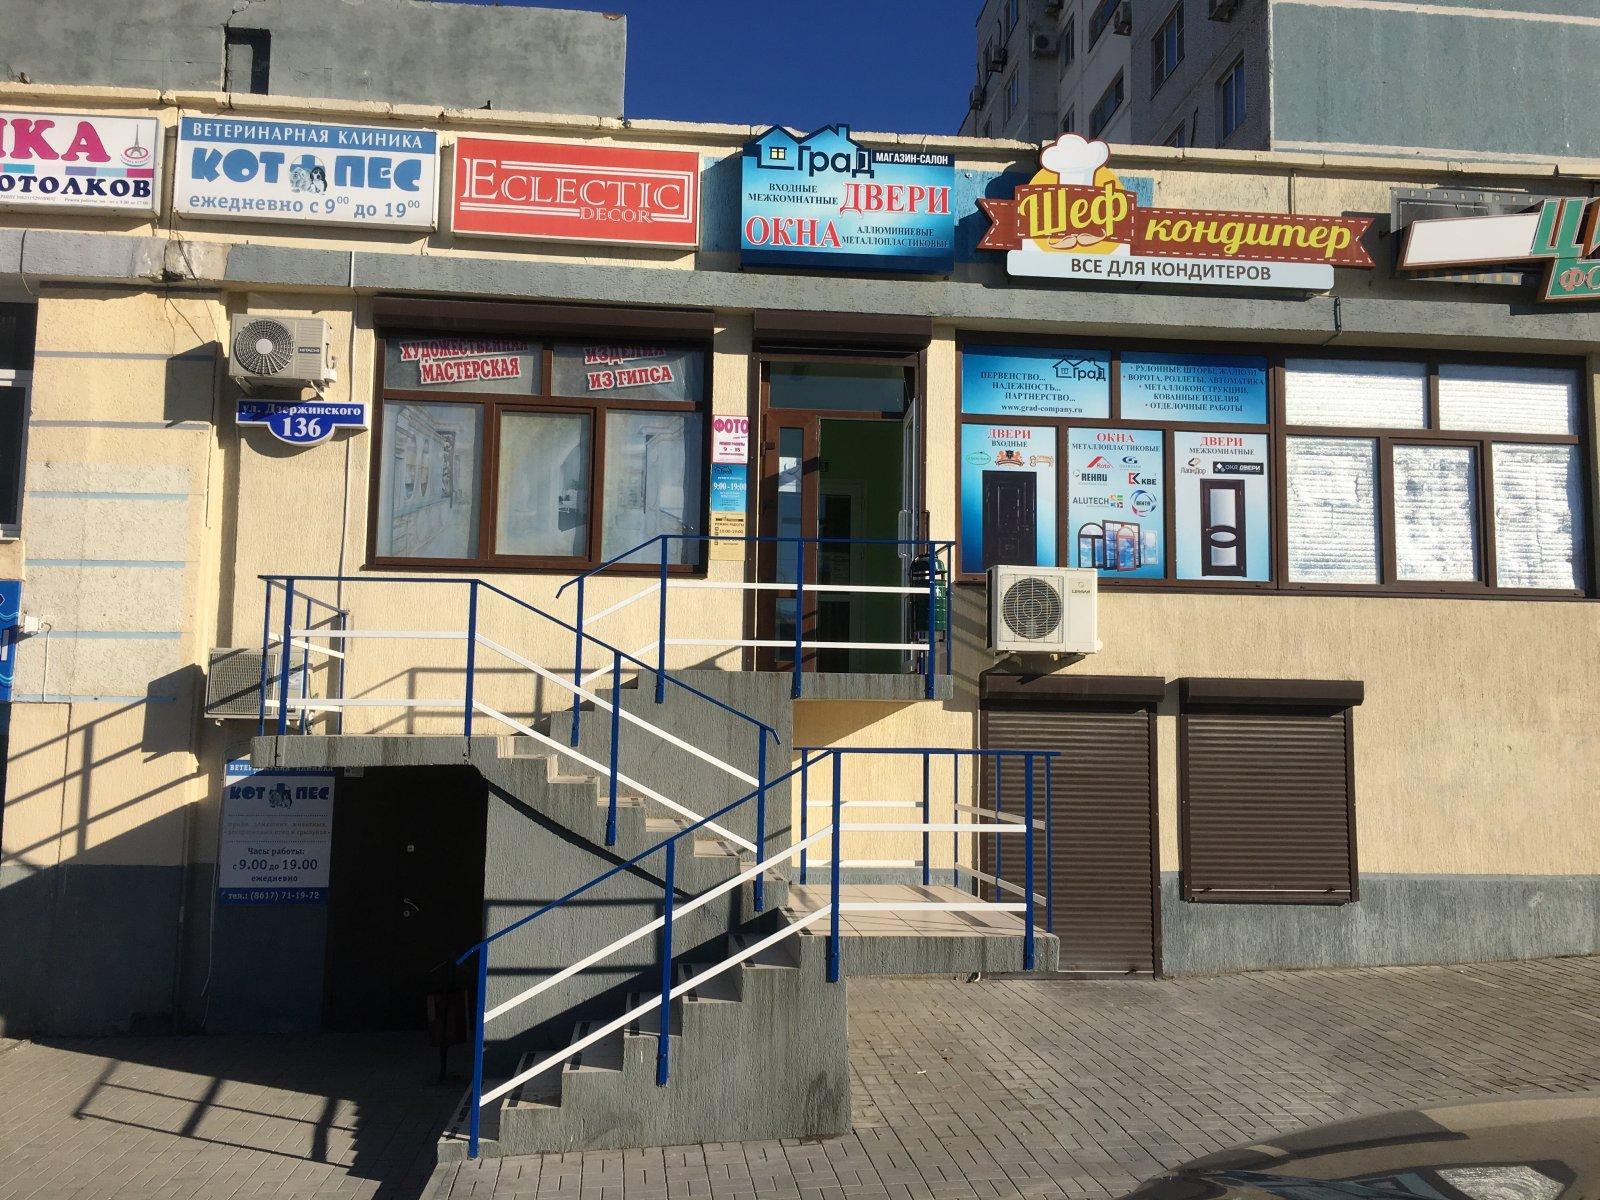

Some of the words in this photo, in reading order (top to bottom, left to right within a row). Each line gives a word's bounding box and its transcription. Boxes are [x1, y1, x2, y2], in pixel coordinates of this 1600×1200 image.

[193, 122, 329, 143] ВЕТЕРИНАРНАЯ
[338, 130, 422, 149] КЛИНИКА
[876, 151, 949, 165] МАГАЗИН-САЛОН
[191, 147, 285, 183] КОТ
[334, 155, 422, 192] ПЕС
[769, 183, 818, 193] ВХОДНЫЕ
[748, 193, 839, 205] МЕЖКОМНАТНЫЕ
[839, 182, 951, 218] ДВЕРИ
[189, 195, 304, 212] ежедневно
[309, 201, 319, 213] с
[354, 204, 377, 219] до
[1019, 182, 1128, 238] Шеф
[580, 206, 654, 223] DECOR
[745, 215, 842, 248] ОКНА
[857, 225, 935, 237] АЛЛЮМИНИЕВЫЕ
[842, 235, 949, 248] МЕТАЛЛОПЛАСТИКОВЫЕ
[1145, 218, 1351, 259] кондитер
[1071, 258, 1103, 273] ВСЕ
[1107, 260, 1145, 277] ДЛЯ
[1151, 262, 1271, 281] КОНДИТЕРОВ
[422, 357, 520, 382] МАСТЕРСКАЯ
[589, 371, 614, 389] ИЗ
[617, 366, 673, 386] ГИПСА
[992, 382, 1061, 392] НАДЕЖНОСТЬ...
[1005, 393, 1076, 402] ПАРТНЕРСТВО...
[266, 403, 361, 416] Дзержинского
[1001, 404, 1083, 414] www.grad-company.ru
[1150, 402, 1207, 411] ОТДЕЛОЧНЫЕ
[1209, 404, 1243, 412] РАБОТЫ
[282, 417, 321, 437] 136
[713, 418, 749, 434] ФОТО
[989, 429, 1031, 439] ДВЕРИ
[1096, 433, 1134, 442] ОКНА
[1072, 443, 1160, 452] МЕТАЛЛОПЛАСТИКОВЫЕ
[1200, 436, 1243, 447] ДВЕРИ
[1189, 447, 1255, 455] МЕЖКОМНАТНЫЕ
[1072, 497, 1109, 505] ALUTECH
[230, 786, 265, 800] КОТ
[295, 786, 330, 800] ПЕС
[247, 847, 269, 855] Часы
[271, 847, 305, 857] работы:
[239, 859, 268, 870] 9.00
[282, 859, 318, 870] 19.00
[250, 892, 279, 900] (8617)
[281, 892, 320, 900] 71-19-72
